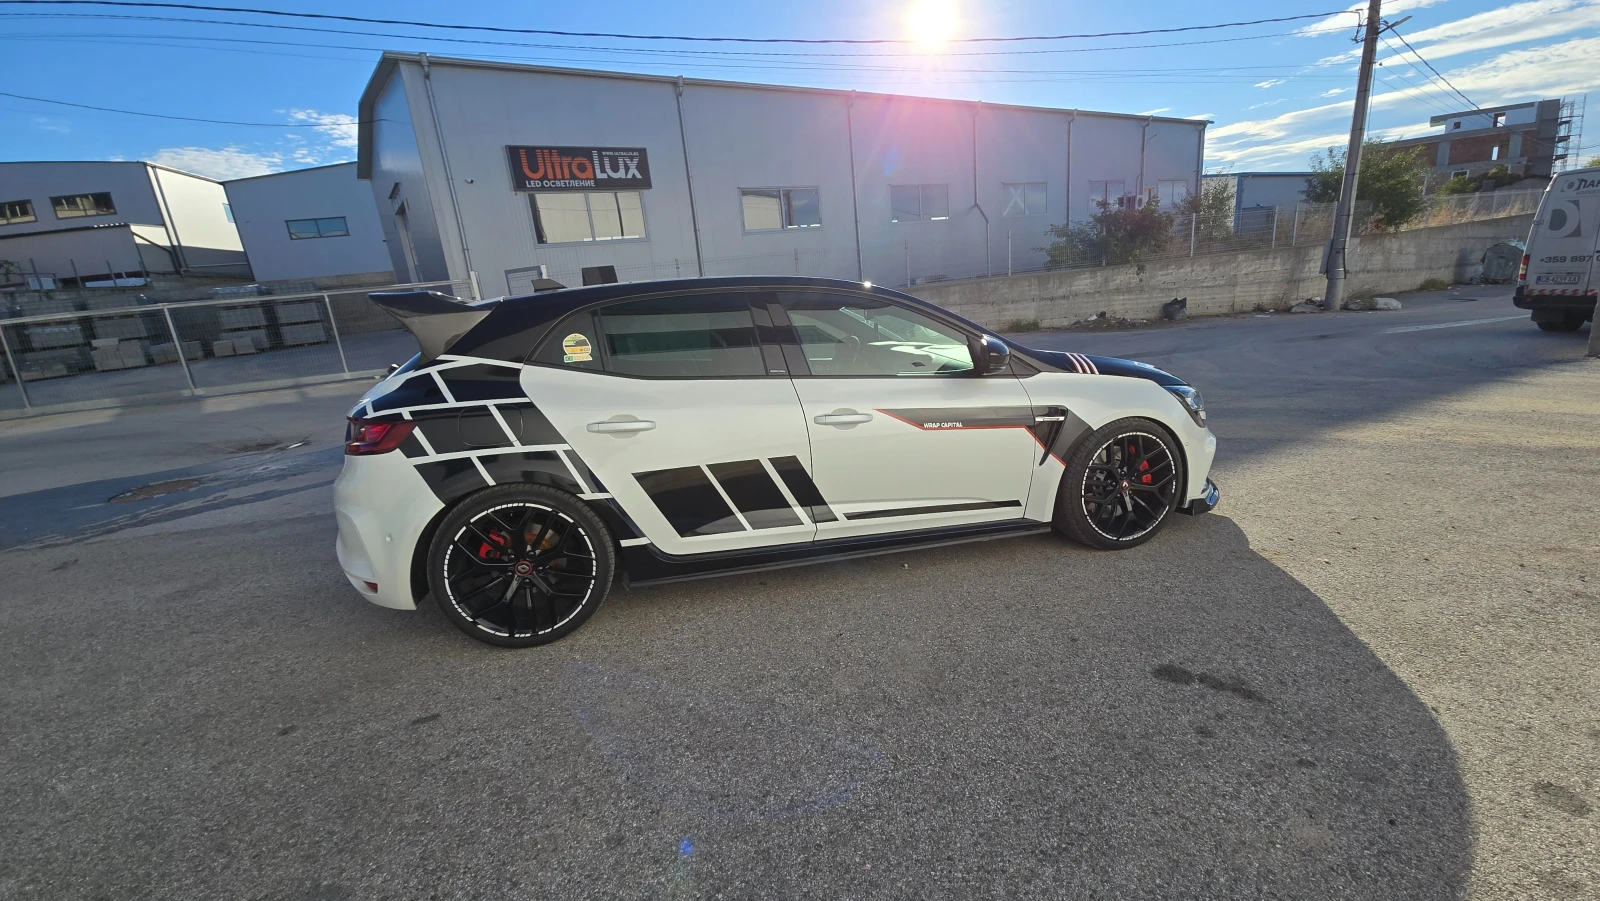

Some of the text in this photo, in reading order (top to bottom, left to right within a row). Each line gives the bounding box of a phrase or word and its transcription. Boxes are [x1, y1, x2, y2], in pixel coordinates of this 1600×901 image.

[526, 179, 596, 188] LED ОСВЕТЛЕНИЕ
[1540, 255, 1567, 264] +359
[1570, 254, 1593, 263] 897
